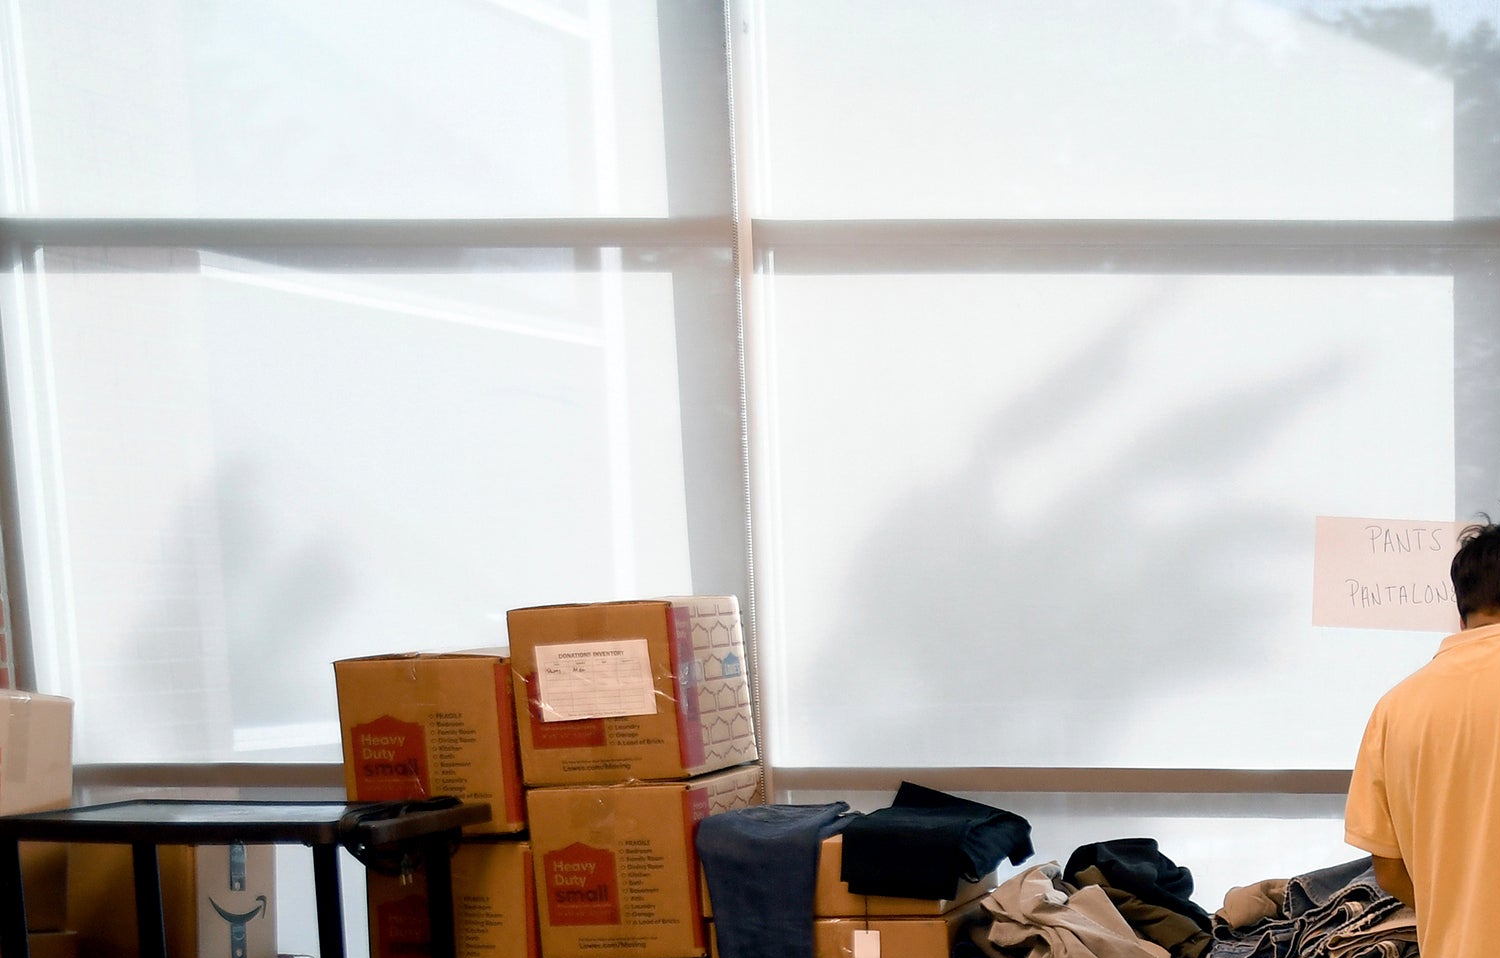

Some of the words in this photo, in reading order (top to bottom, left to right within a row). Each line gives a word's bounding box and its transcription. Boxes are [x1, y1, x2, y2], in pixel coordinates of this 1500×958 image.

[1365, 525, 1442, 553] PANTS
[360, 733, 406, 748] Heavy
[362, 748, 396, 761] Duty
[364, 757, 419, 777] small
[553, 860, 596, 875] Heavy
[554, 874, 587, 888] Duty
[556, 884, 609, 903] small
